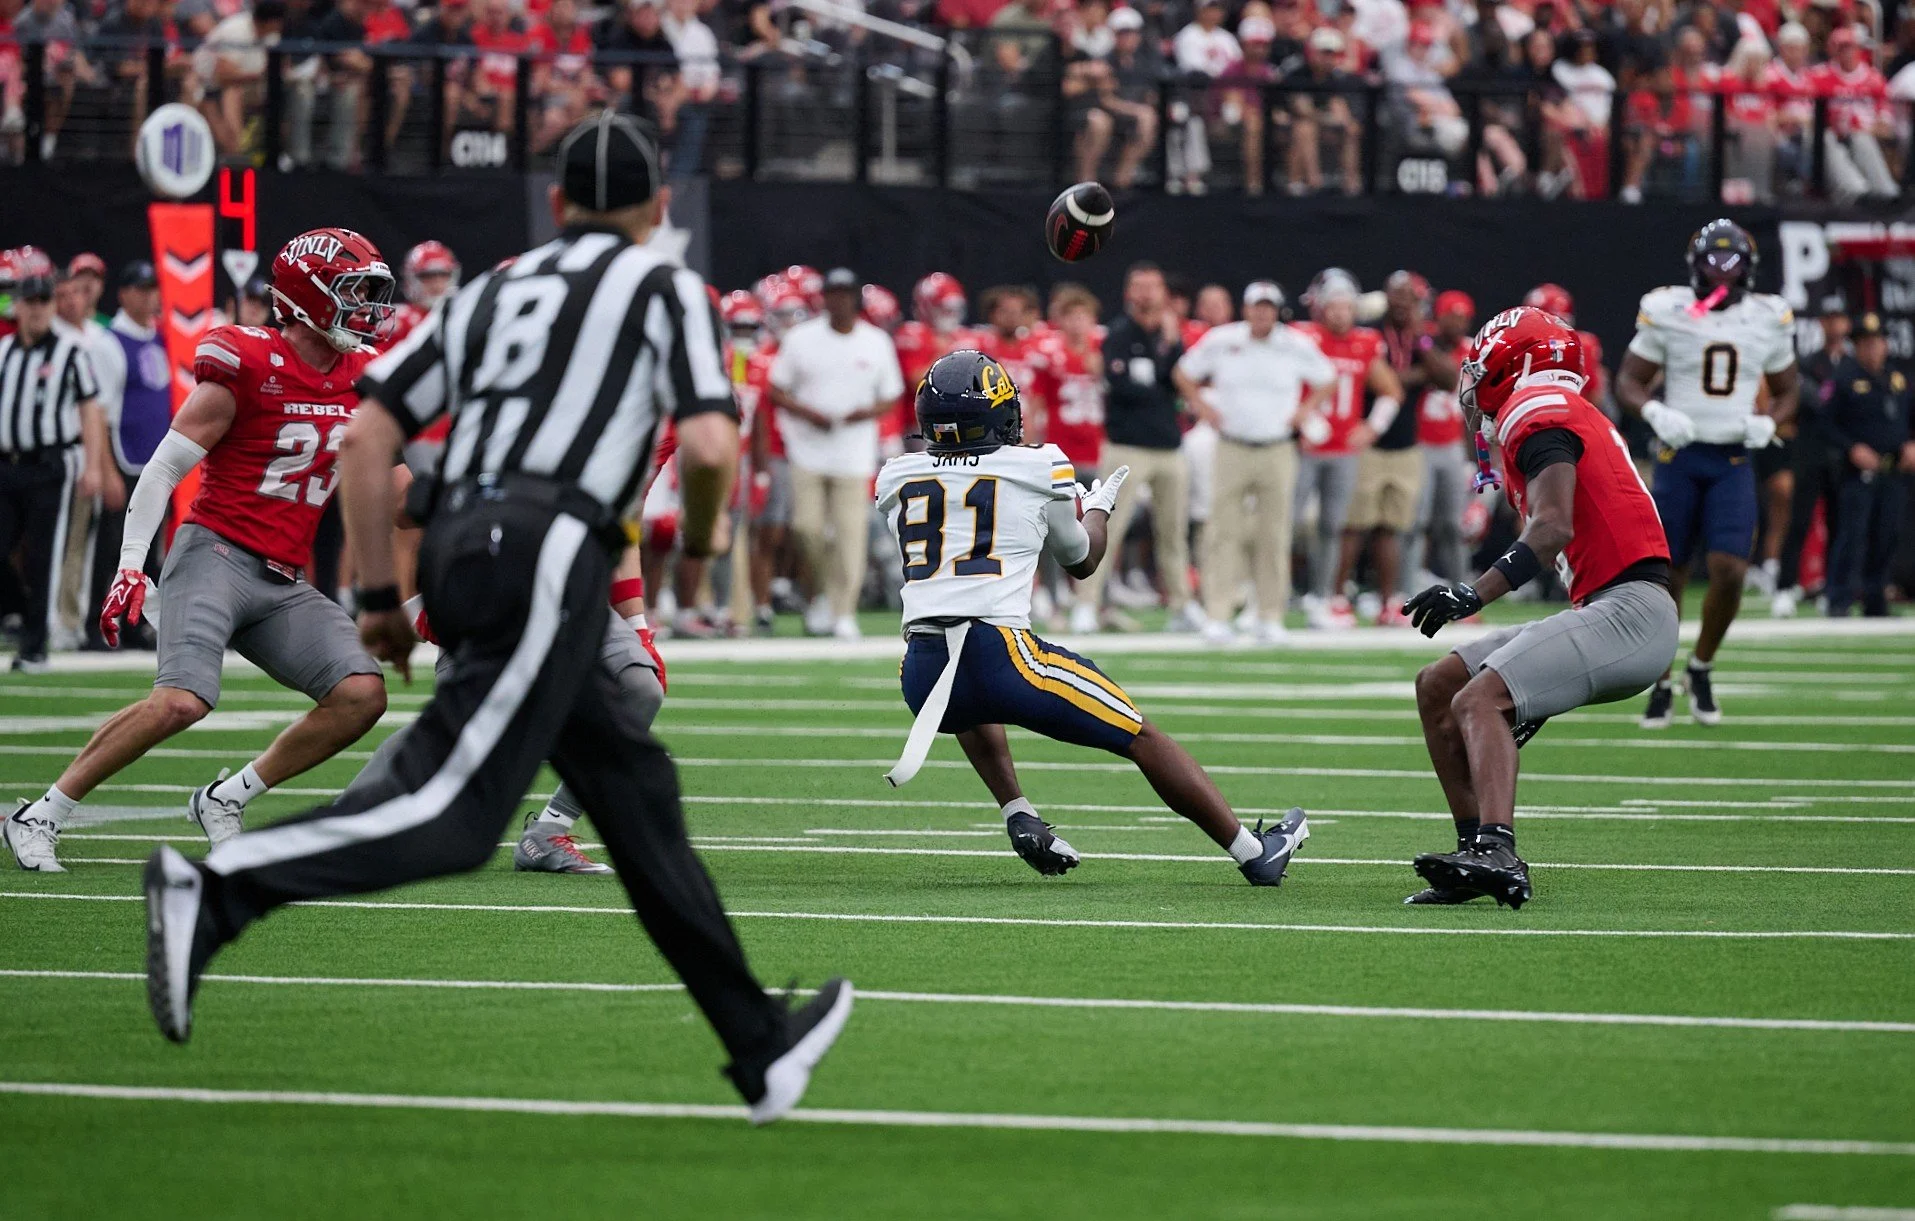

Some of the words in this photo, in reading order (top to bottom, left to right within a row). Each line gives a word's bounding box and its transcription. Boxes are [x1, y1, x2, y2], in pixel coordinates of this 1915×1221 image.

[219, 167, 256, 253] 4
[280, 236, 345, 266] UNLV
[470, 273, 569, 391] B
[1474, 307, 1525, 350] UNLV
[981, 362, 1015, 409] Cal
[1702, 342, 1738, 397] 0
[256, 421, 349, 508] 23
[897, 475, 1003, 583] 81
[522, 838, 542, 862] NIKE
